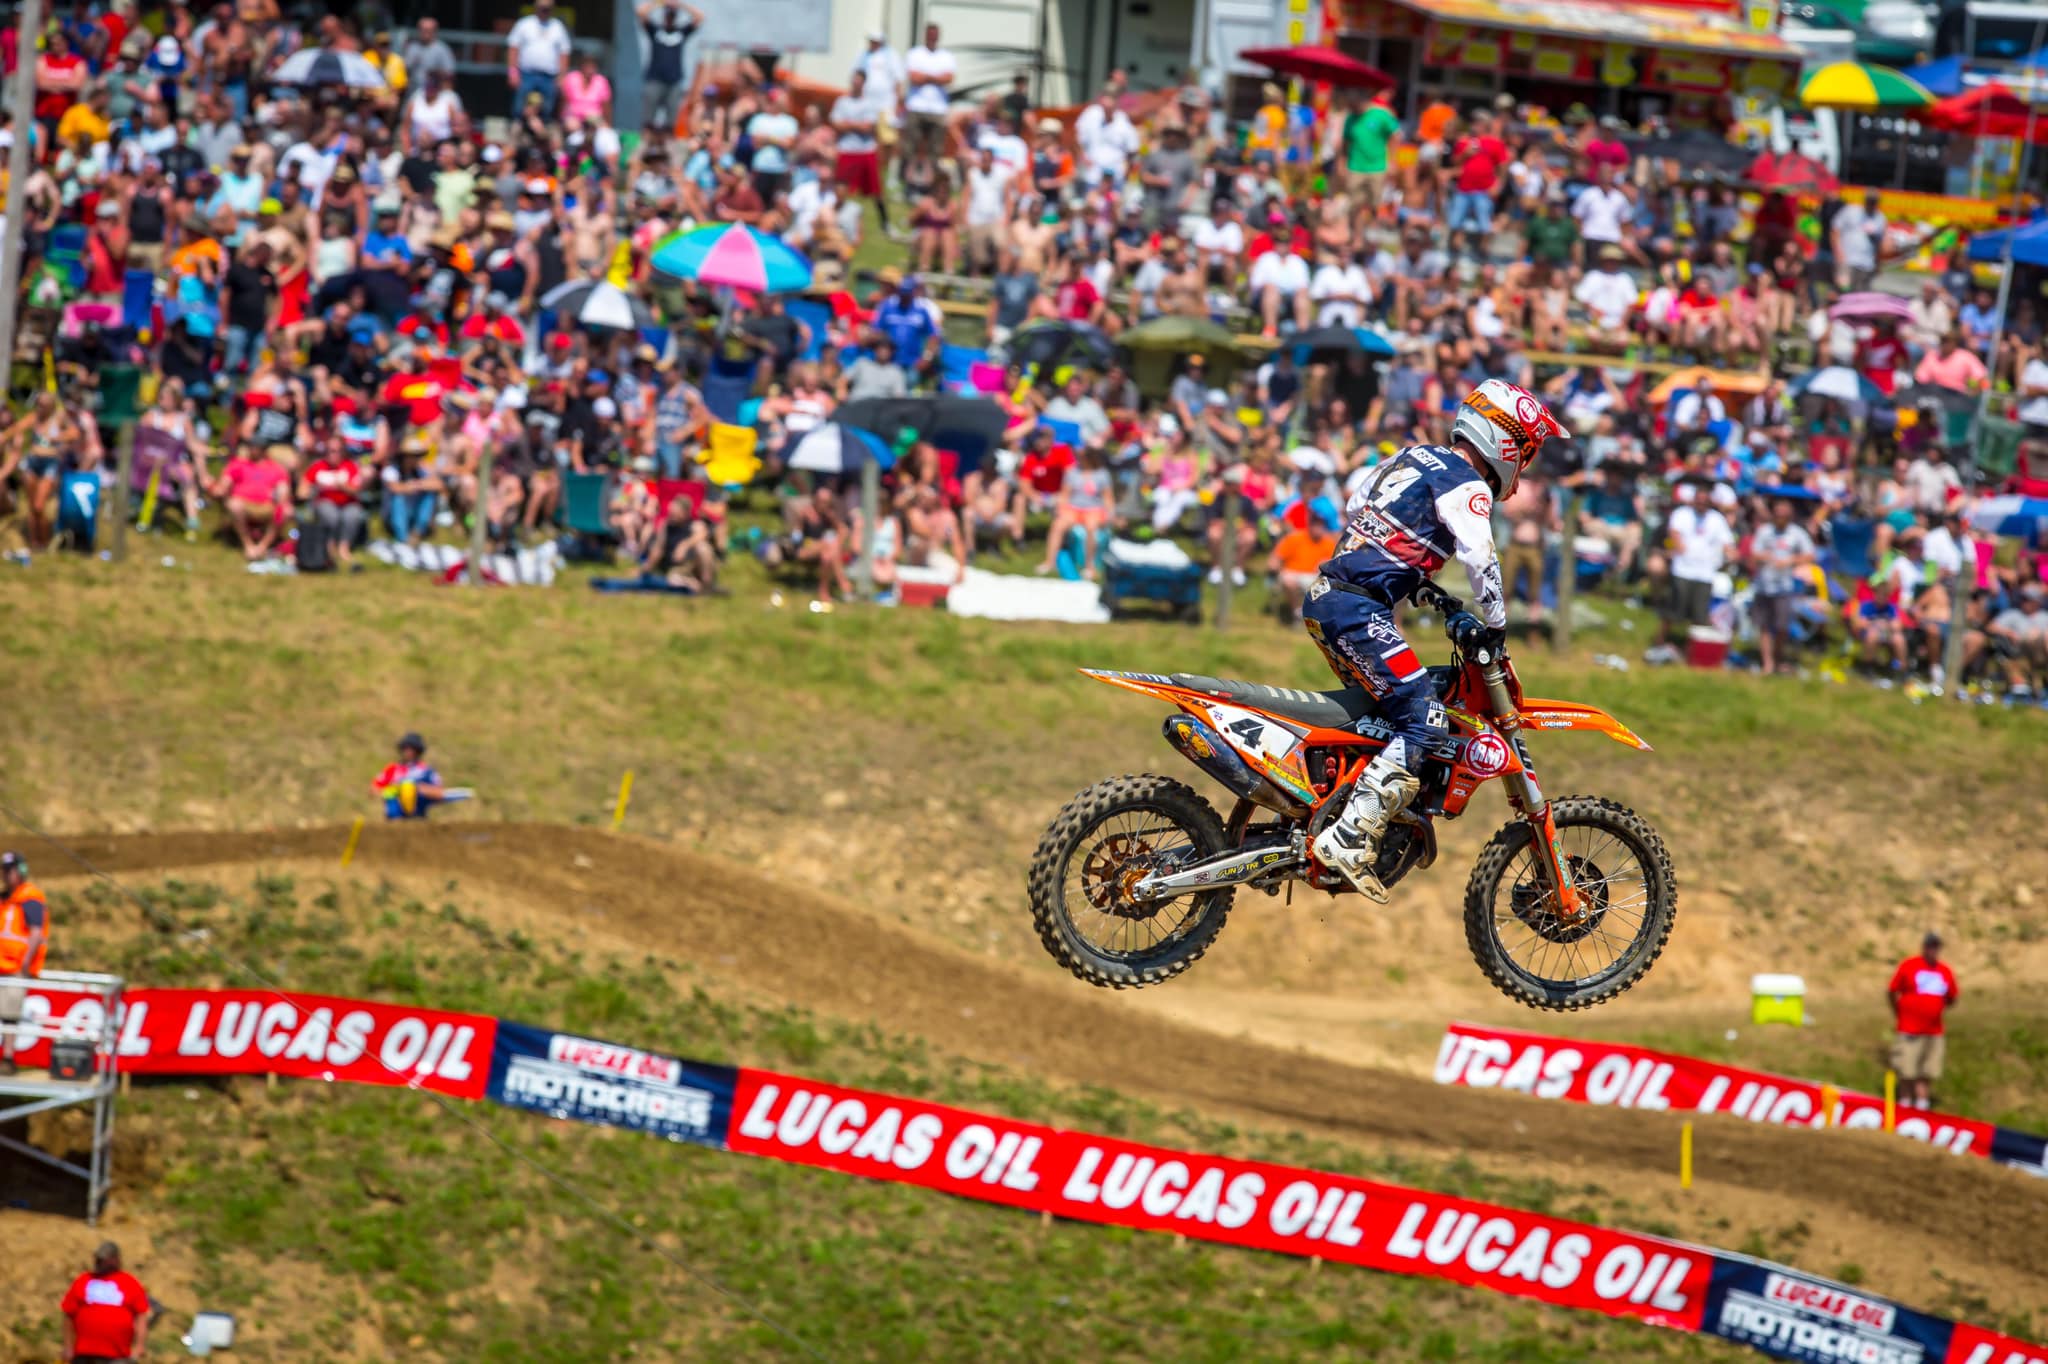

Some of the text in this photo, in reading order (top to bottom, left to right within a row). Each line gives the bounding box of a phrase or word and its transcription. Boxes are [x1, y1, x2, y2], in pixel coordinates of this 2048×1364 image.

[1372, 466, 1423, 509] 4
[1229, 718, 1264, 749] 4
[177, 1001, 475, 1080] LUCAS OIL
[558, 1042, 633, 1075] LUCAS
[505, 1065, 712, 1128] MOTOCROSS
[1585, 1053, 1675, 1111] OIL
[738, 1084, 943, 1170] LUCAS
[945, 1124, 1043, 1191] OIL
[1062, 1146, 1367, 1247] LUCAS OIL
[1386, 1202, 1693, 1312] LUCAS OIL
[1774, 1279, 1886, 1329] LUCAS OIL
